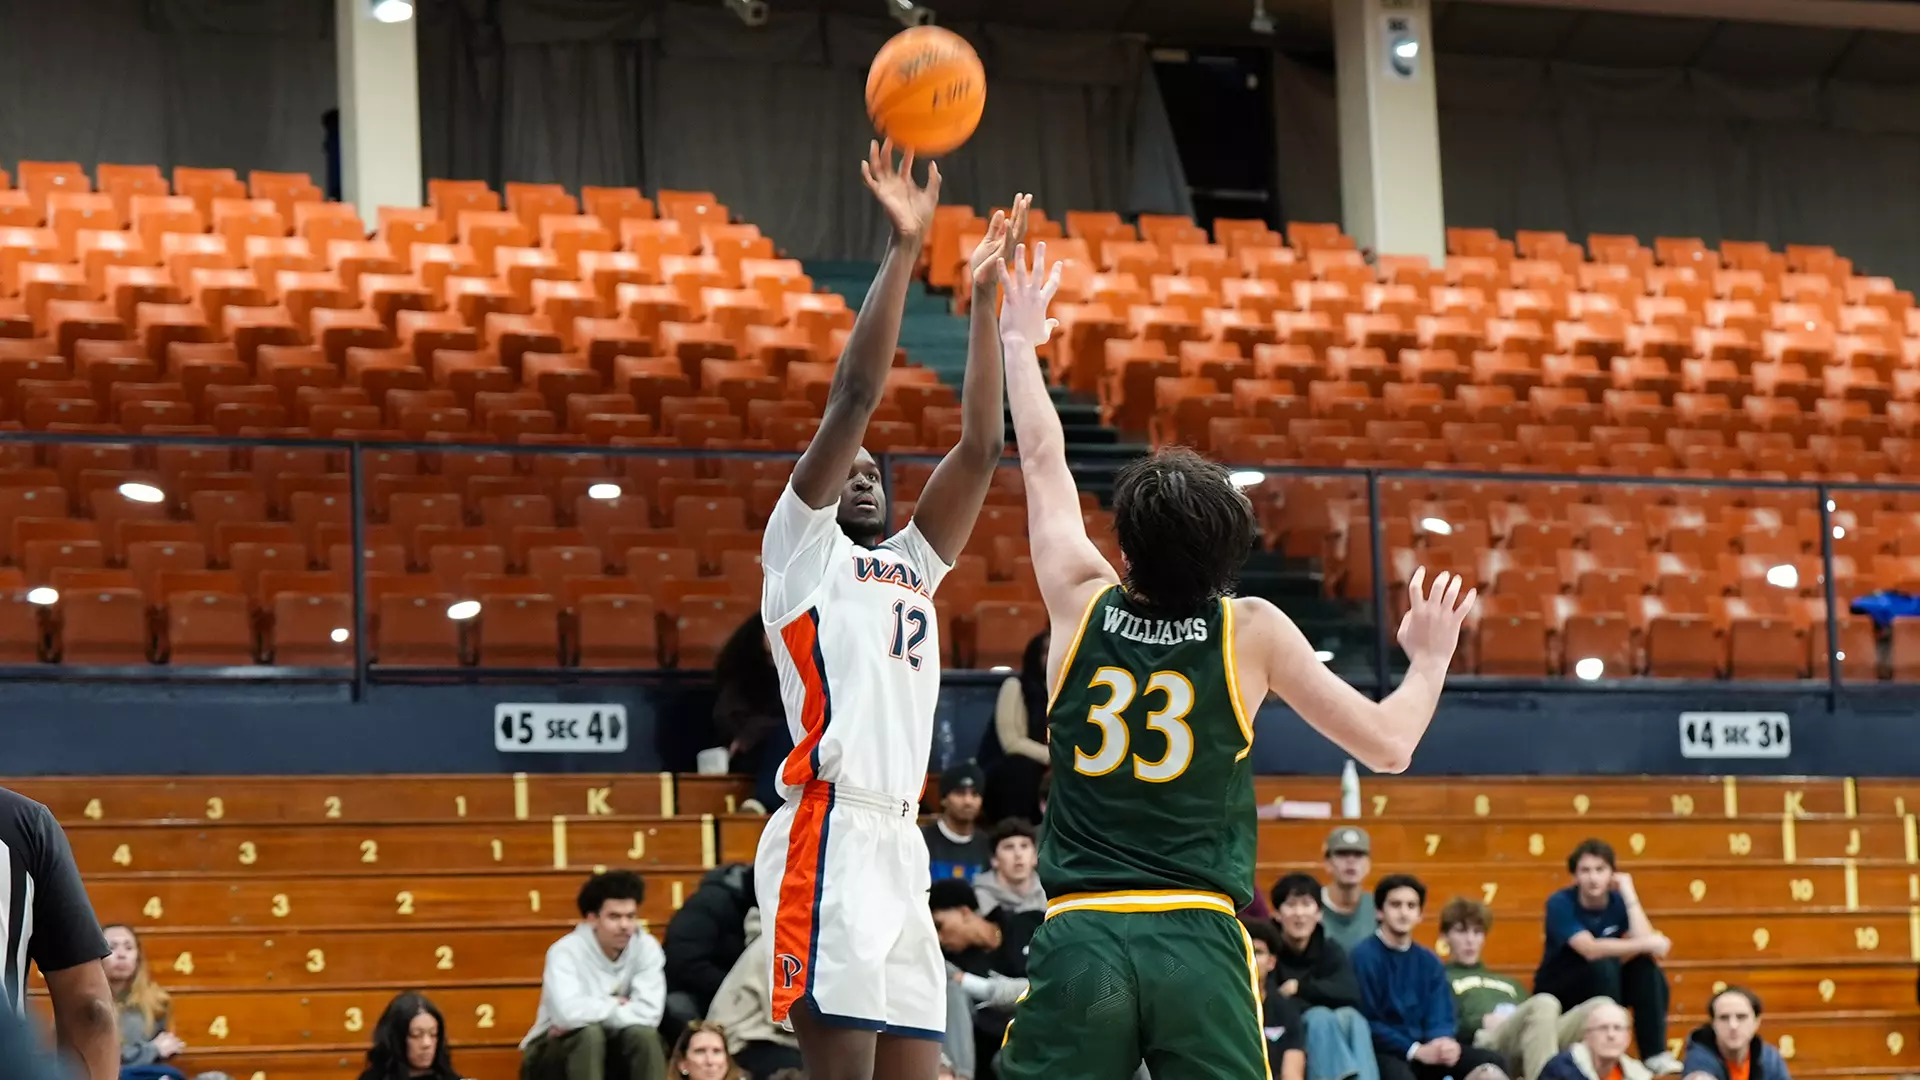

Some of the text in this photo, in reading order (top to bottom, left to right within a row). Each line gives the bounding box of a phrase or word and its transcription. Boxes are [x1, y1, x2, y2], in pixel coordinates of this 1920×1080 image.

[889, 599, 928, 671] 12
[1102, 604, 1209, 646] WILLIAMS
[518, 711, 603, 744] 5 SEC 4
[1074, 666, 1195, 783] 33
[1700, 721, 1713, 749] 4
[1758, 721, 1771, 748] 3
[84, 799, 102, 819] 4
[207, 797, 224, 819] 3
[326, 797, 341, 818] 2
[456, 796, 466, 816] 1
[587, 788, 613, 815] K
[1373, 795, 1387, 816] 7
[1475, 795, 1489, 816] 8
[1574, 795, 1590, 815] 9
[1672, 795, 1693, 816] 10
[1784, 791, 1804, 816] K
[114, 831, 645, 865] 4 3 2 1 J
[1425, 829, 1860, 856] 7 8 9 10 J
[144, 897, 162, 918] 4
[272, 893, 289, 917] 3
[397, 891, 414, 914] 2
[529, 890, 540, 911] 1
[1482, 882, 1498, 905] 7
[1690, 879, 1706, 901] 9
[1790, 878, 1814, 901] 10
[1753, 927, 1770, 950] 9
[1855, 926, 1879, 950] 10
[174, 946, 453, 975] 4 3 2
[1819, 979, 1836, 1002] 9
[208, 1003, 495, 1039] 4 3 2
[1779, 1034, 1796, 1059] 8
[1887, 1032, 1904, 1055] 9
